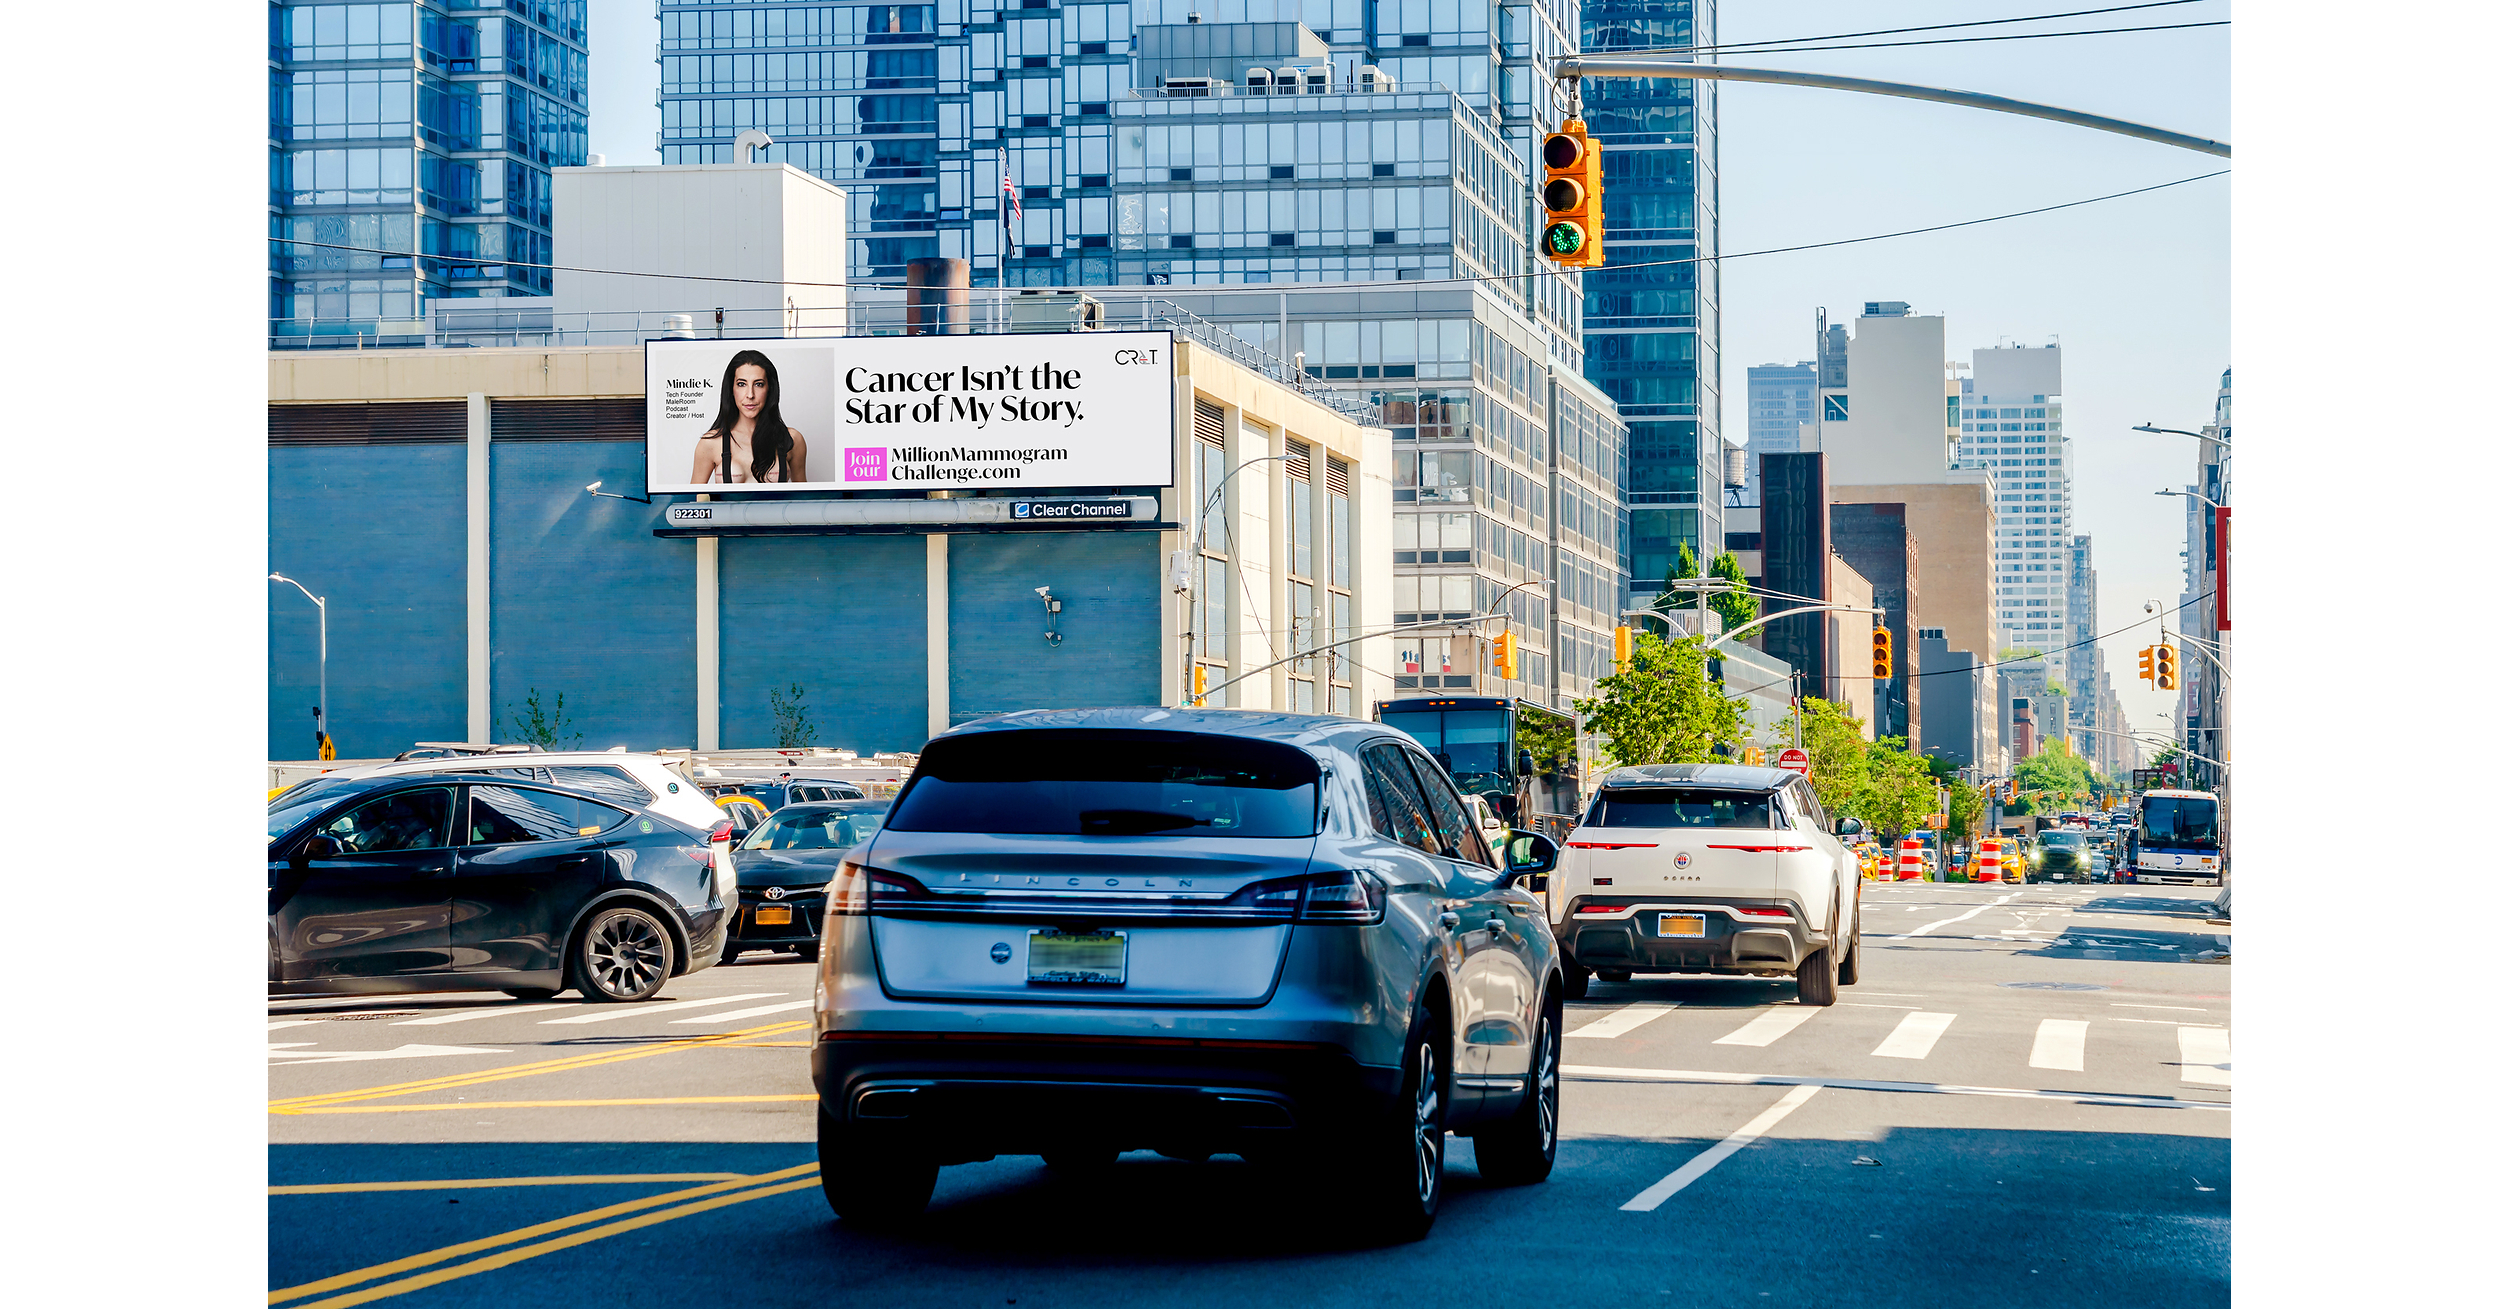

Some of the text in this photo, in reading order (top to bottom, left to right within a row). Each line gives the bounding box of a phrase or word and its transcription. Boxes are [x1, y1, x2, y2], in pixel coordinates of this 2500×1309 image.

[666, 378, 714, 389] Mindie K.
[845, 366, 955, 394] Cancer
[1029, 361, 1082, 391] the
[845, 394, 1085, 430] Star of My Story.
[850, 450, 881, 469] Join
[891, 446, 1069, 465] MillionMammogram
[852, 465, 882, 479] our
[891, 464, 1021, 484] Challenge.com
[675, 509, 711, 519] 922301
[1032, 503, 1126, 517] Clear Channel
[960, 872, 1193, 888] LINCOLN
